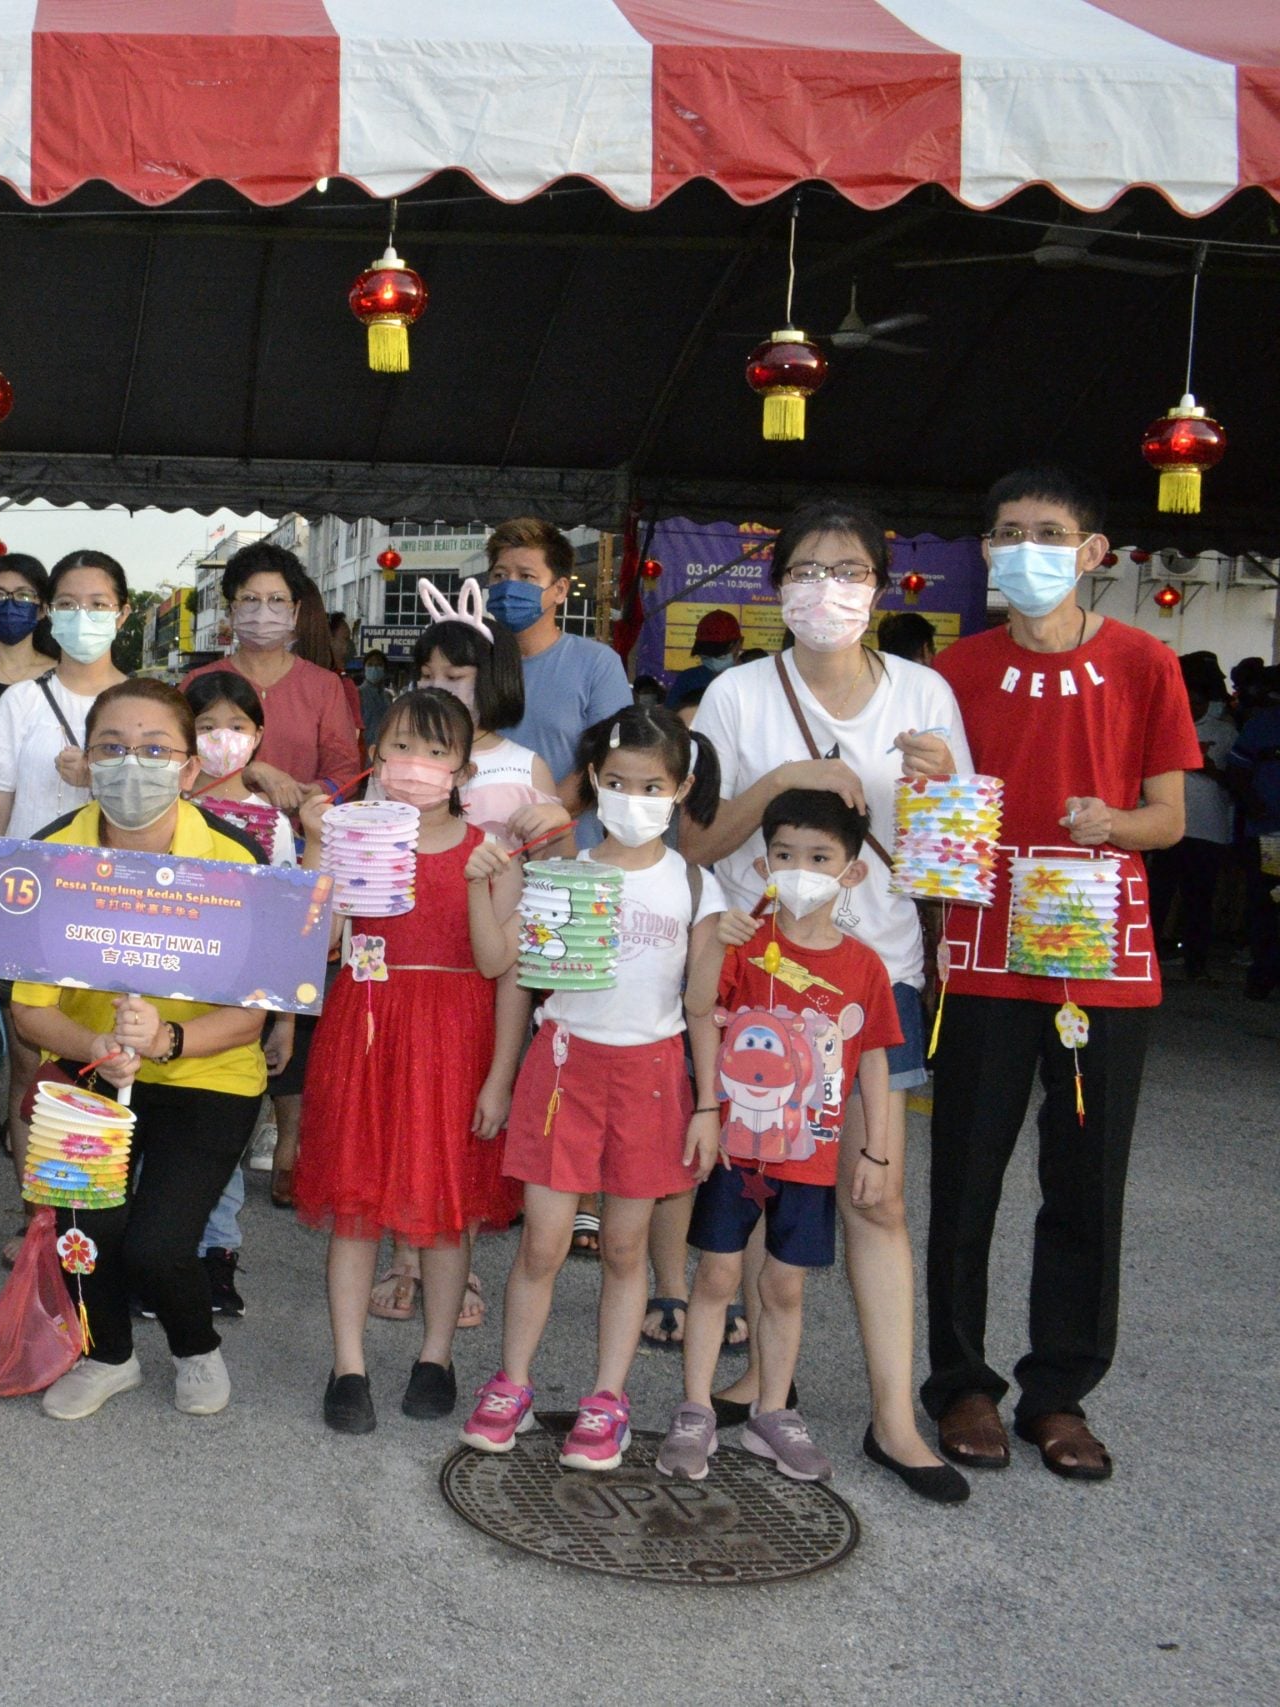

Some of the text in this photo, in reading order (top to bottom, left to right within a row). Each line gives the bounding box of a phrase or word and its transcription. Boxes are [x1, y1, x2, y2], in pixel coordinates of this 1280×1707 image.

[434, 538, 458, 551] BEAUTY
[686, 562, 763, 578] 03-0-2022
[364, 628, 386, 637] PUSAT
[1000, 660, 1105, 699] REAL
[4, 877, 35, 906] 15
[55, 877, 242, 908] Pesta Tanglung Kedah Sejahtera
[66, 924, 220, 956] SJK(C) KEAT HWA H
[622, 935, 659, 947] PORE
[102, 948, 181, 971] 吉华H校
[581, 1484, 709, 1519] JPP
